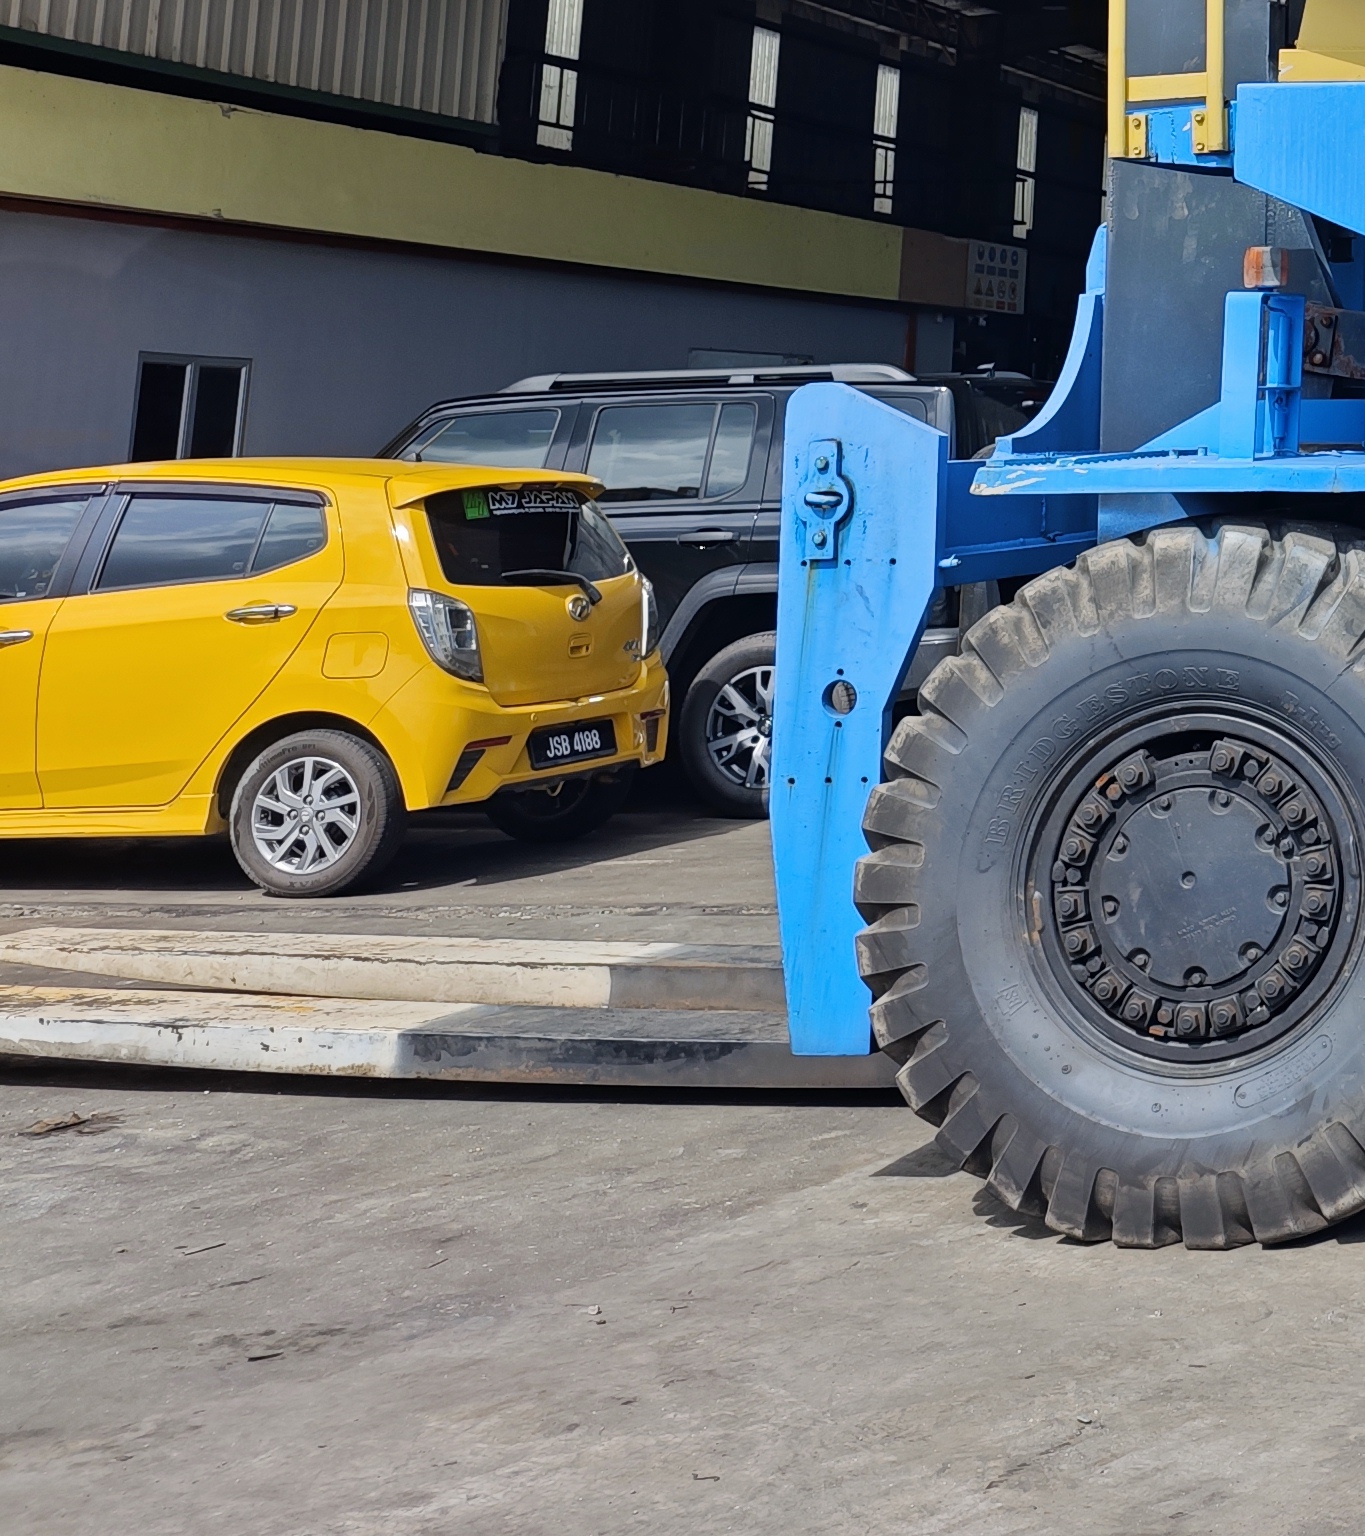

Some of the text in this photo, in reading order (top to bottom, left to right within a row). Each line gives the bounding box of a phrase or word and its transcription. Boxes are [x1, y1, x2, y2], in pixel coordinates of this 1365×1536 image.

[521, 490, 580, 507] JAPAN
[546, 729, 601, 758] JSB 4188
[985, 666, 1241, 846] BRIDGESTONE
